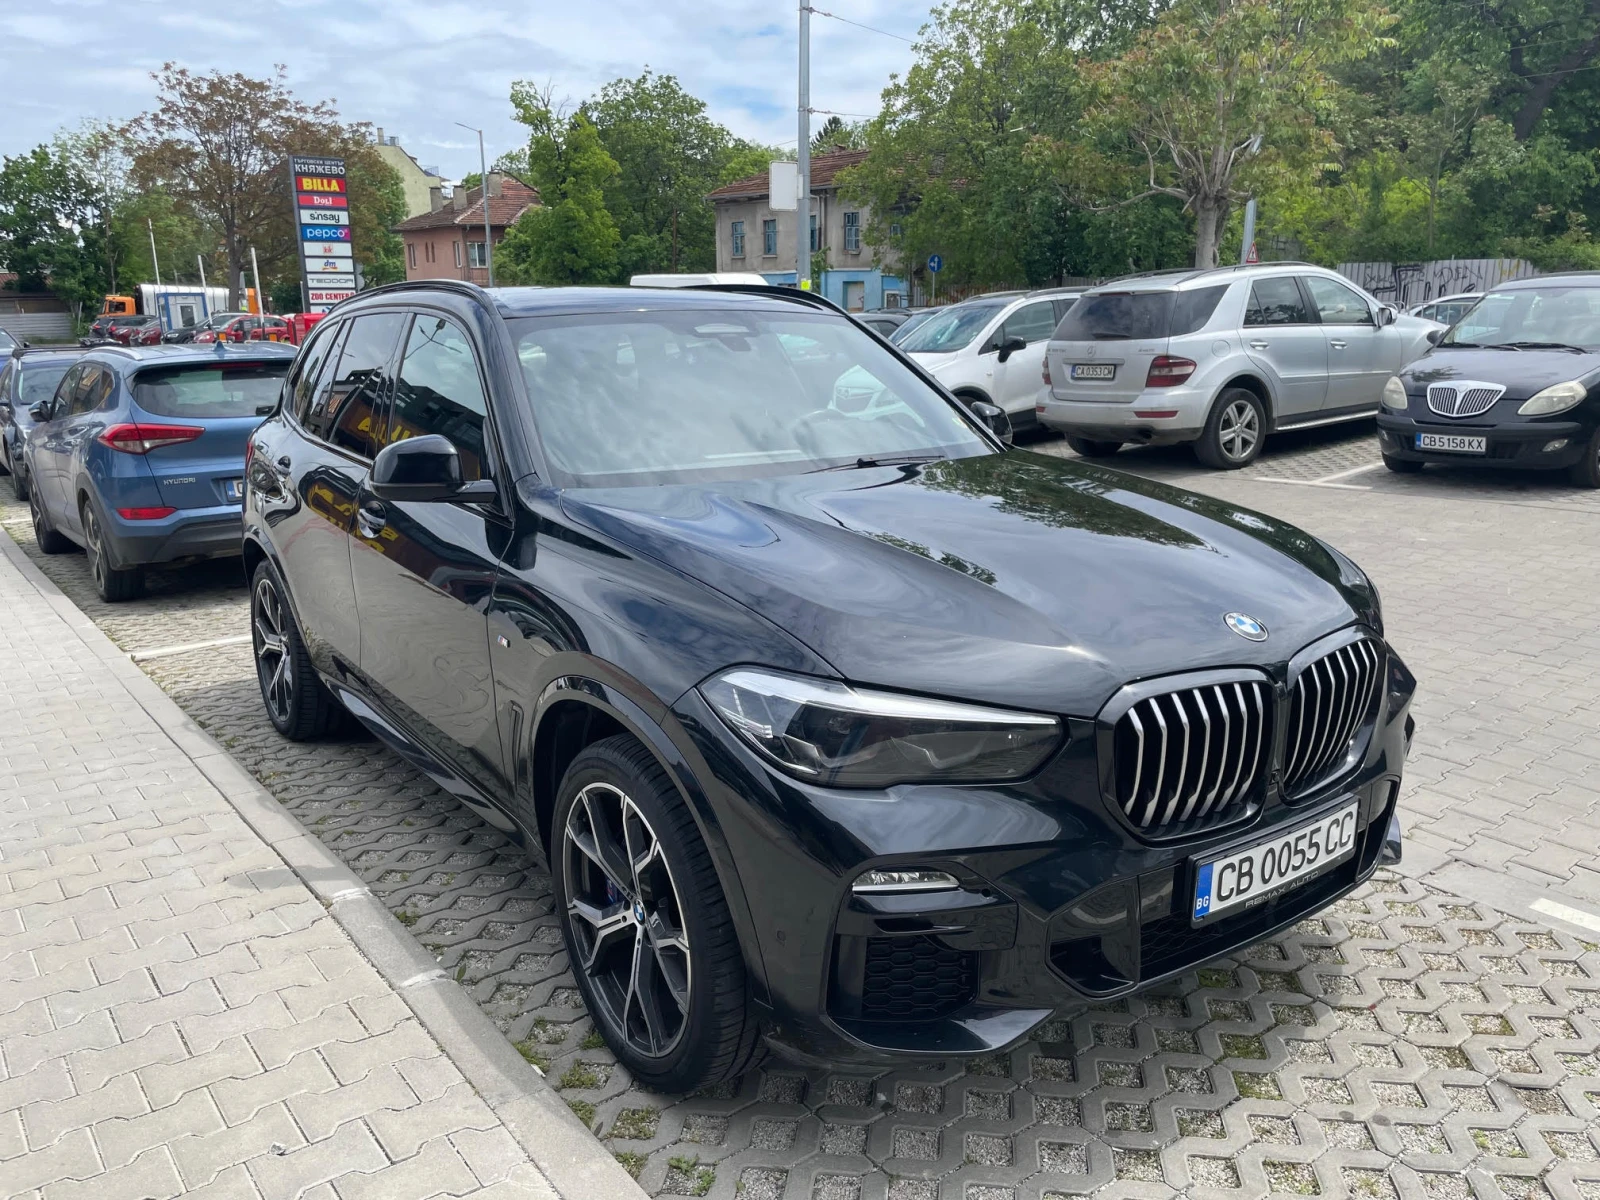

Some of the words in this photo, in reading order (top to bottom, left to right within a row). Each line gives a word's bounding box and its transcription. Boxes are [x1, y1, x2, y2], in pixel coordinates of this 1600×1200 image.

[295, 164, 345, 174] КНЯЖЕВО
[302, 178, 340, 192] BILLA
[310, 212, 340, 224] sinsay
[306, 228, 345, 238] pepco
[310, 292, 324, 300] ZOO
[1086, 366, 1102, 376] 0353
[1422, 436, 1436, 446] CB
[1438, 437, 1466, 448] 5158
[1468, 438, 1483, 450] KX
[1216, 855, 1254, 902] CB
[1260, 826, 1322, 884] 0055
[1325, 811, 1354, 855] CC
[1244, 887, 1288, 908] REMAX
[1290, 870, 1320, 888] AUTO
[1196, 896, 1209, 910] BG
